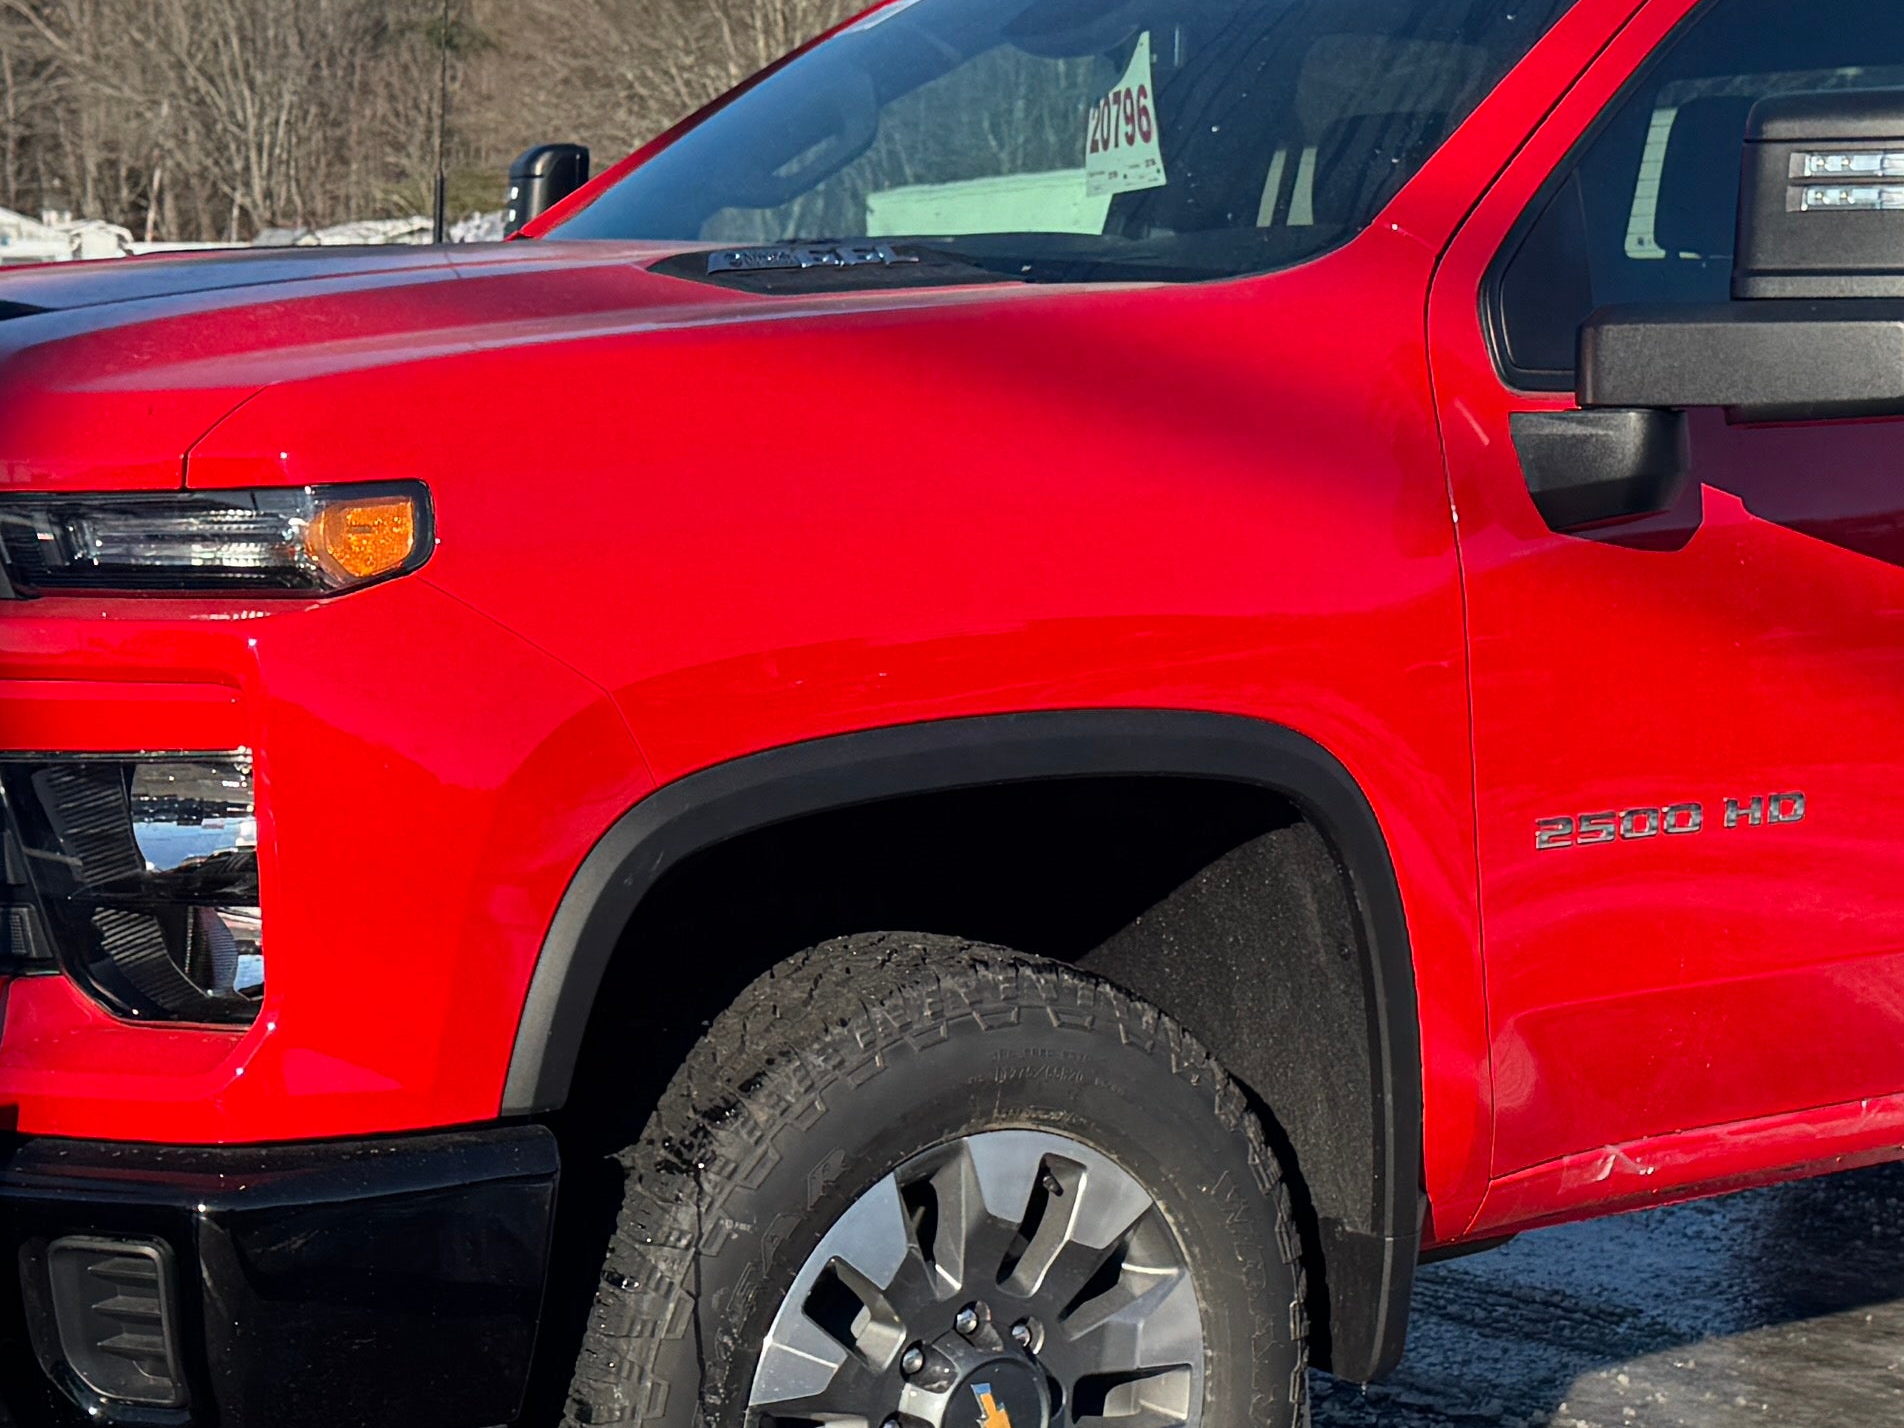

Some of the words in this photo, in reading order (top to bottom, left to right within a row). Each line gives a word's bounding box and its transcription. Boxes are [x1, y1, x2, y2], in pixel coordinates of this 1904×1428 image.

[1089, 83, 1152, 154] 20796
[1534, 802, 1703, 851] 2500
[1723, 790, 1807, 828] HD
